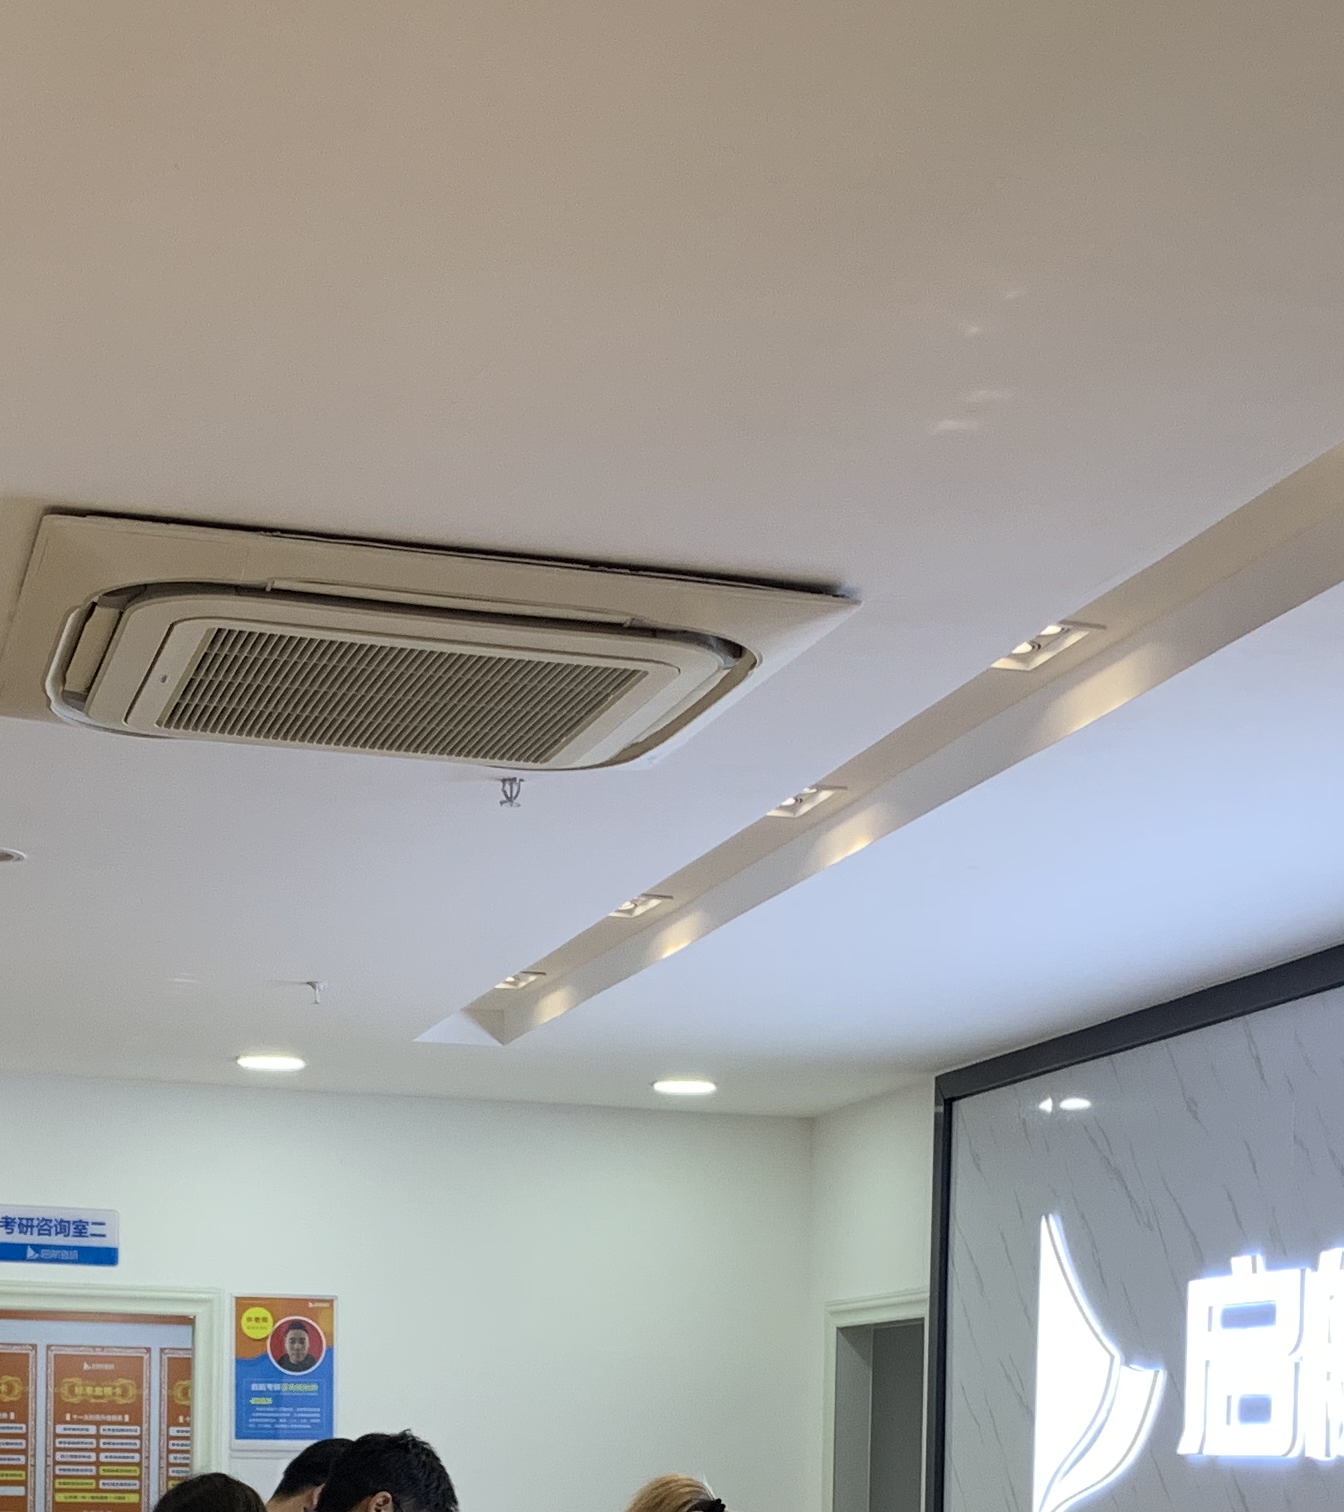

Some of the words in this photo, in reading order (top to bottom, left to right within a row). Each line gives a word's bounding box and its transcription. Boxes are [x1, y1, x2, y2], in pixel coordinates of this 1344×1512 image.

[0, 1215, 107, 1238] 考研咨询室二
